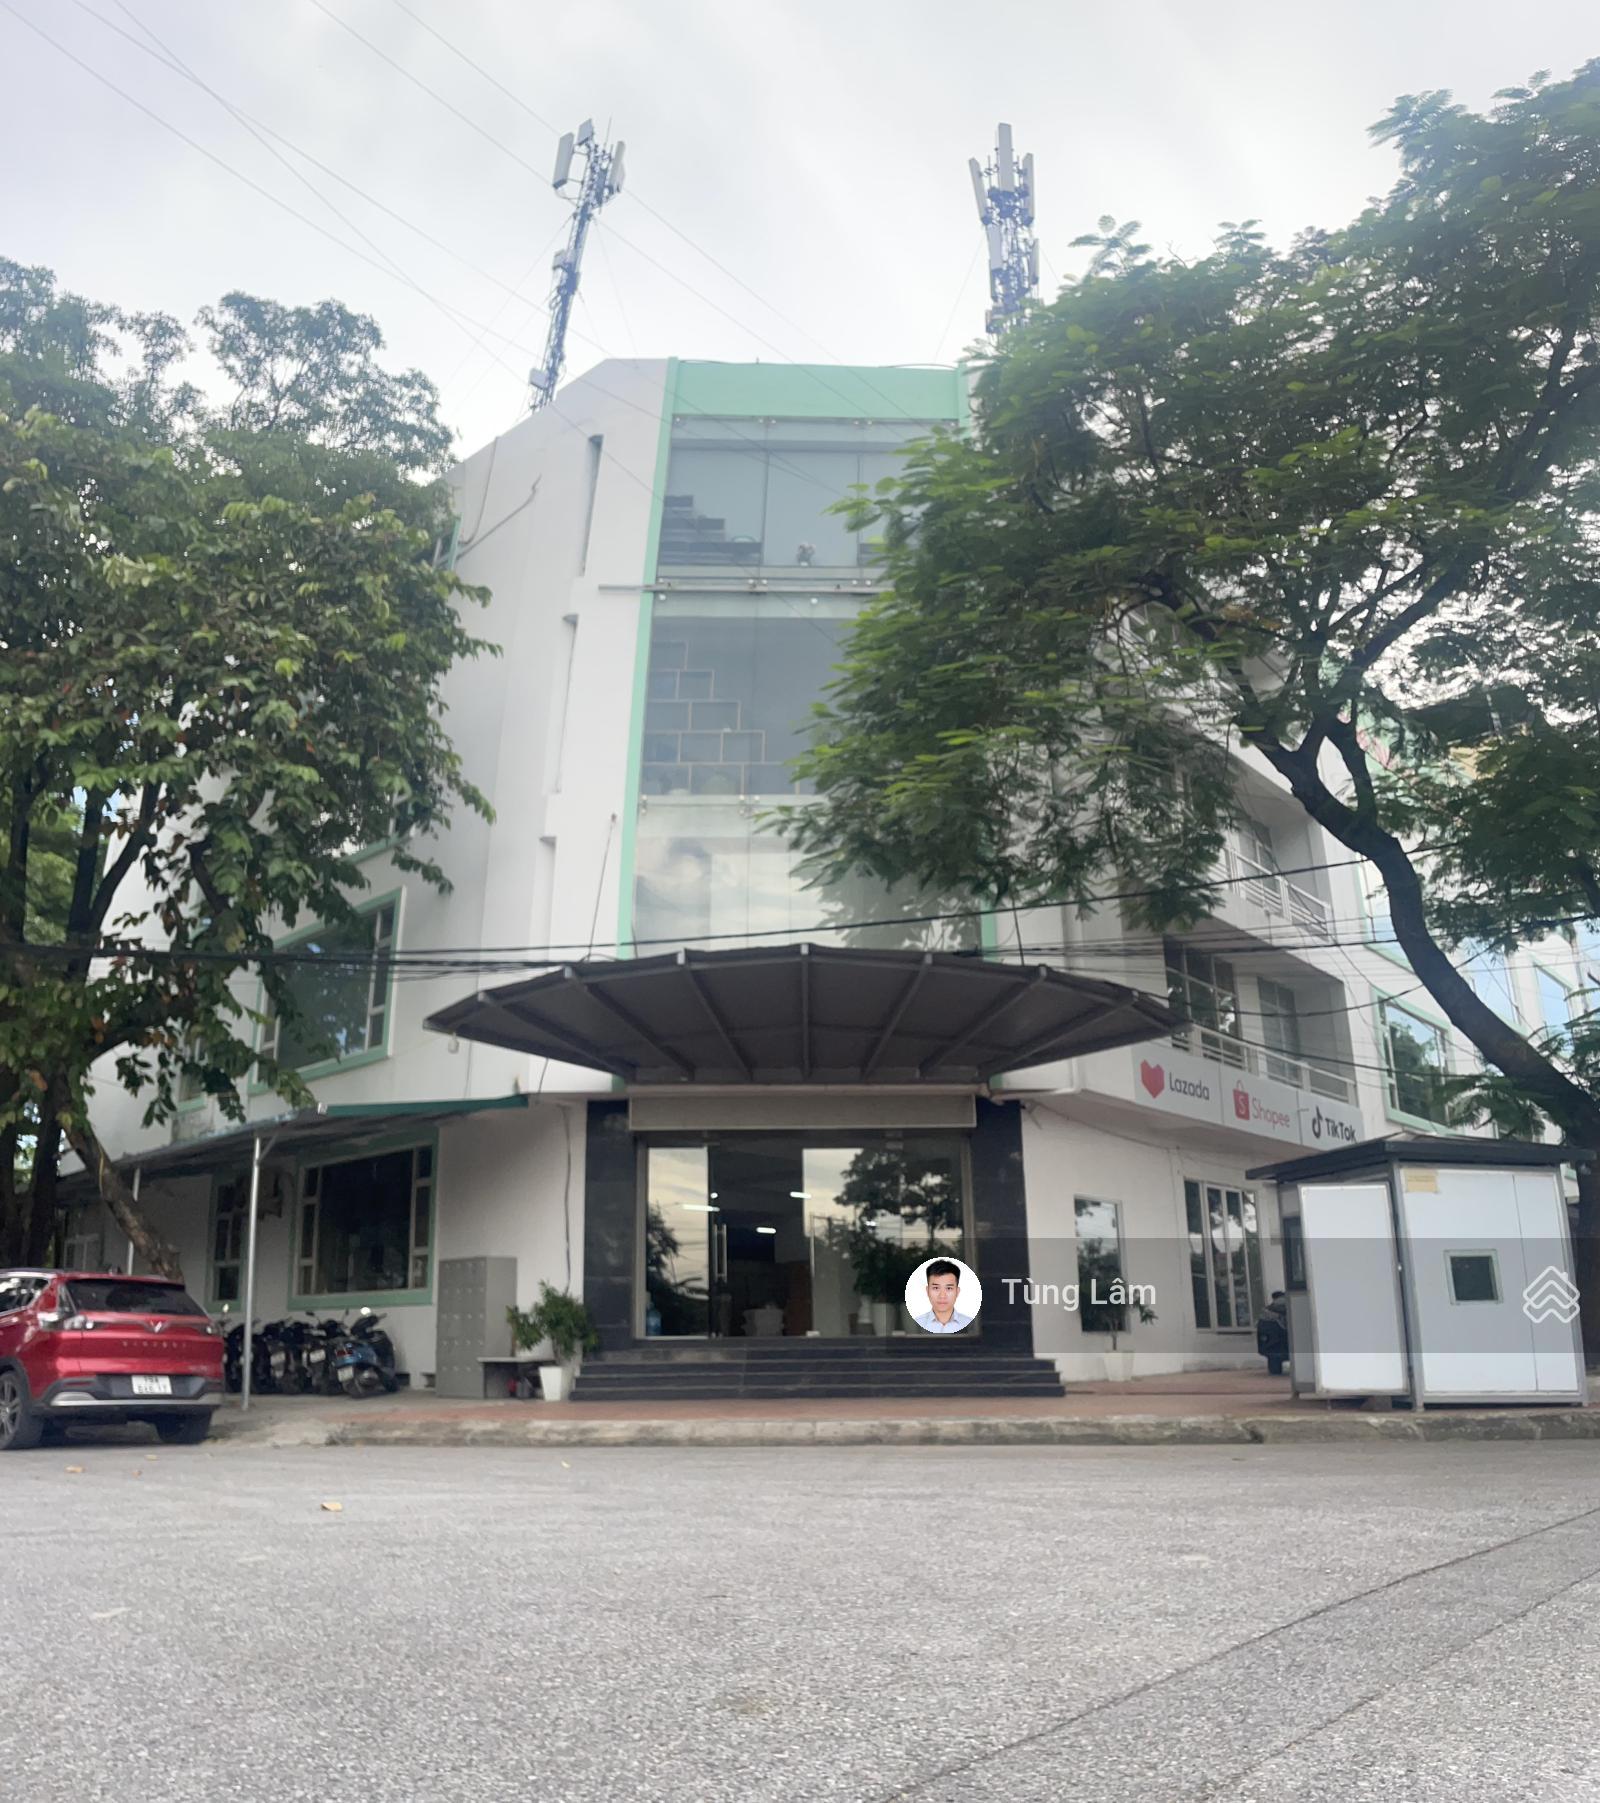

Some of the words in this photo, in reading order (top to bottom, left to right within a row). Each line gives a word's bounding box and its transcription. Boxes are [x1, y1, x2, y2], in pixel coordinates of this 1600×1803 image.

[1169, 1072, 1210, 1101] Lazada
[1252, 1096, 1291, 1129] Shopee
[1325, 1117, 1357, 1143] TikTok
